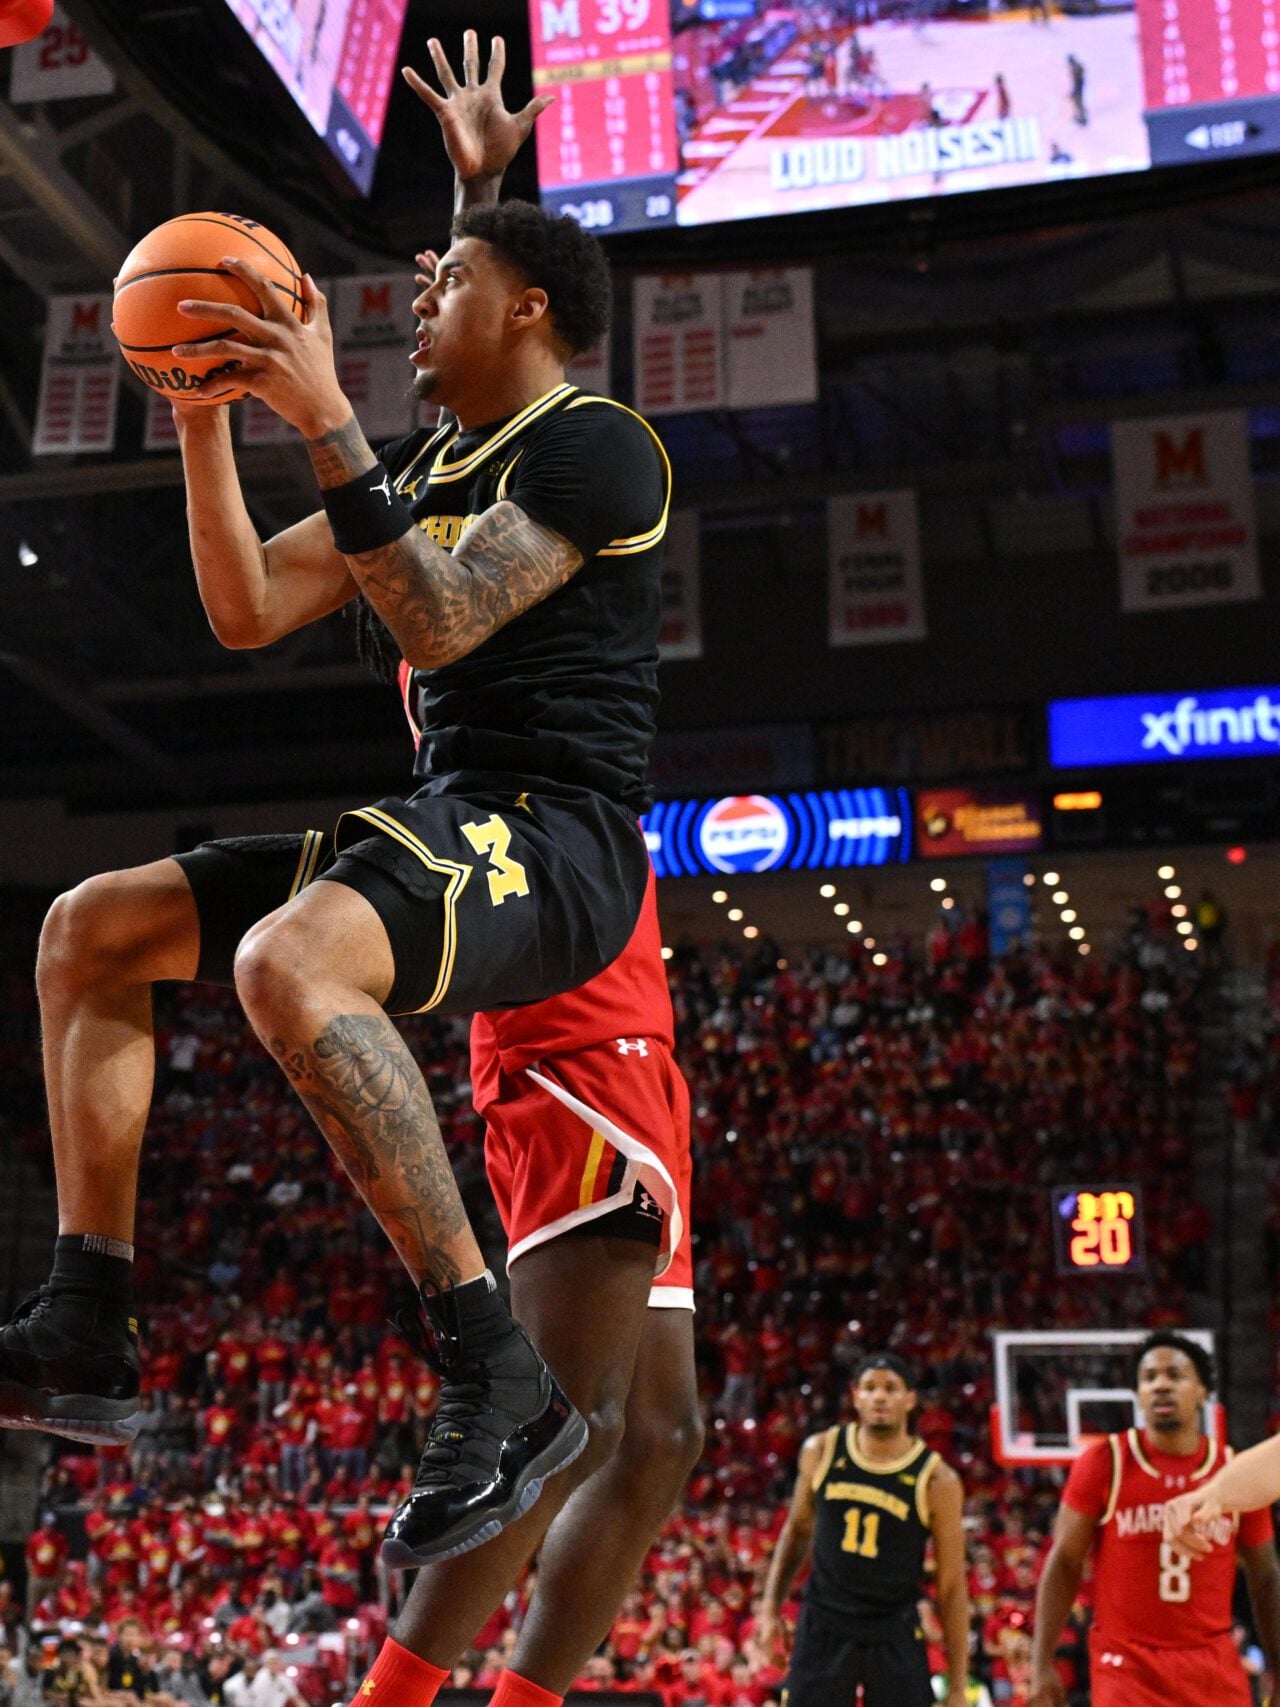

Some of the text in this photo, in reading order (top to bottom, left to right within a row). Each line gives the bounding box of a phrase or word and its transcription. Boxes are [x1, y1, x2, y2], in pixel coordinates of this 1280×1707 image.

[596, 0, 651, 34] 39
[771, 140, 865, 191] LOUD
[1154, 426, 1206, 489] M
[855, 503, 888, 539] M
[460, 814, 529, 906] M
[1071, 1218, 1131, 1266] 20
[842, 1507, 879, 1559] 11
[1159, 1541, 1191, 1603] 8
